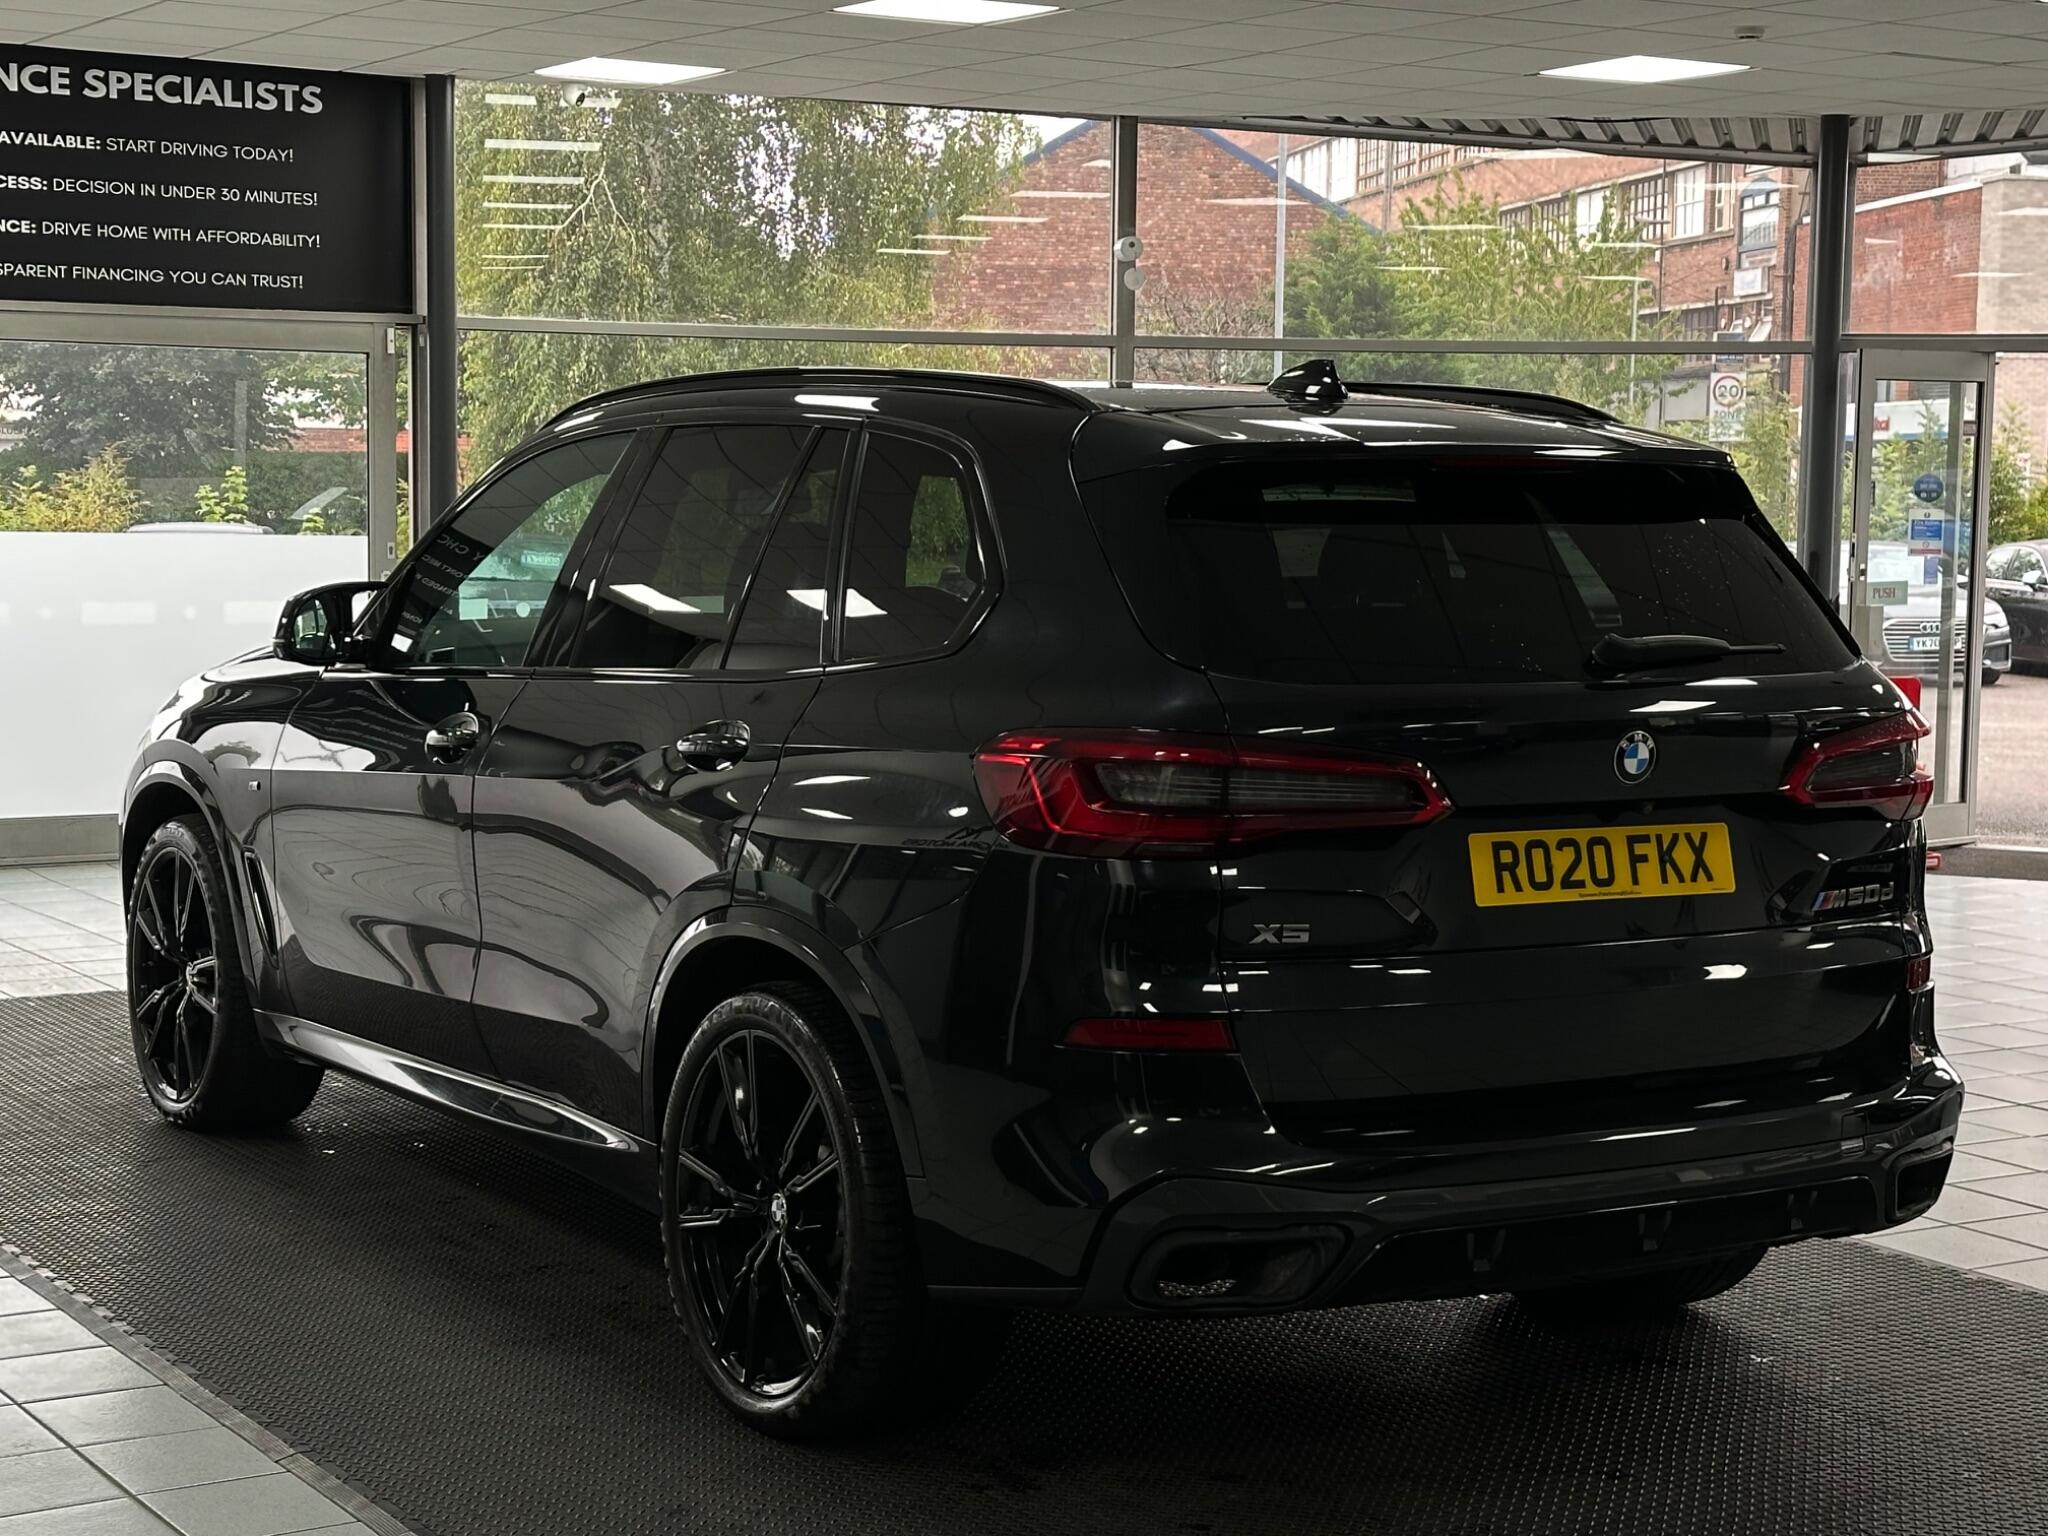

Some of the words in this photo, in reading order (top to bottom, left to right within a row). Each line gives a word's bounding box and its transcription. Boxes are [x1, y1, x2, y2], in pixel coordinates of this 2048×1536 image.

[0, 62, 71, 96] NCE
[82, 68, 323, 114] SPECIALISTS
[0, 130, 101, 150] AVAILABLE:
[106, 137, 156, 154] START
[160, 141, 229, 158] DRIVING
[232, 145, 294, 162] TODAY!
[53, 178, 135, 196] DECISION
[140, 183, 156, 197] IN
[160, 184, 216, 200] UNDER
[220, 188, 240, 202] 30
[244, 189, 318, 206] MINUTES!
[42, 221, 92, 236] DRIVE
[97, 224, 148, 239] HOME
[152, 227, 191, 242] WITH
[195, 229, 321, 248] AFFORDABILITY!
[72, 265, 165, 283] FINANCING
[169, 270, 206, 285] YOU
[211, 272, 247, 287] CAN
[251, 273, 304, 289] TRUST!
[1717, 384, 1739, 398] 20
[1871, 586, 1897, 599] PUSH
[1490, 835, 1616, 894] RO20
[1624, 831, 1715, 886] FKX
[1247, 923, 1310, 945] X5
